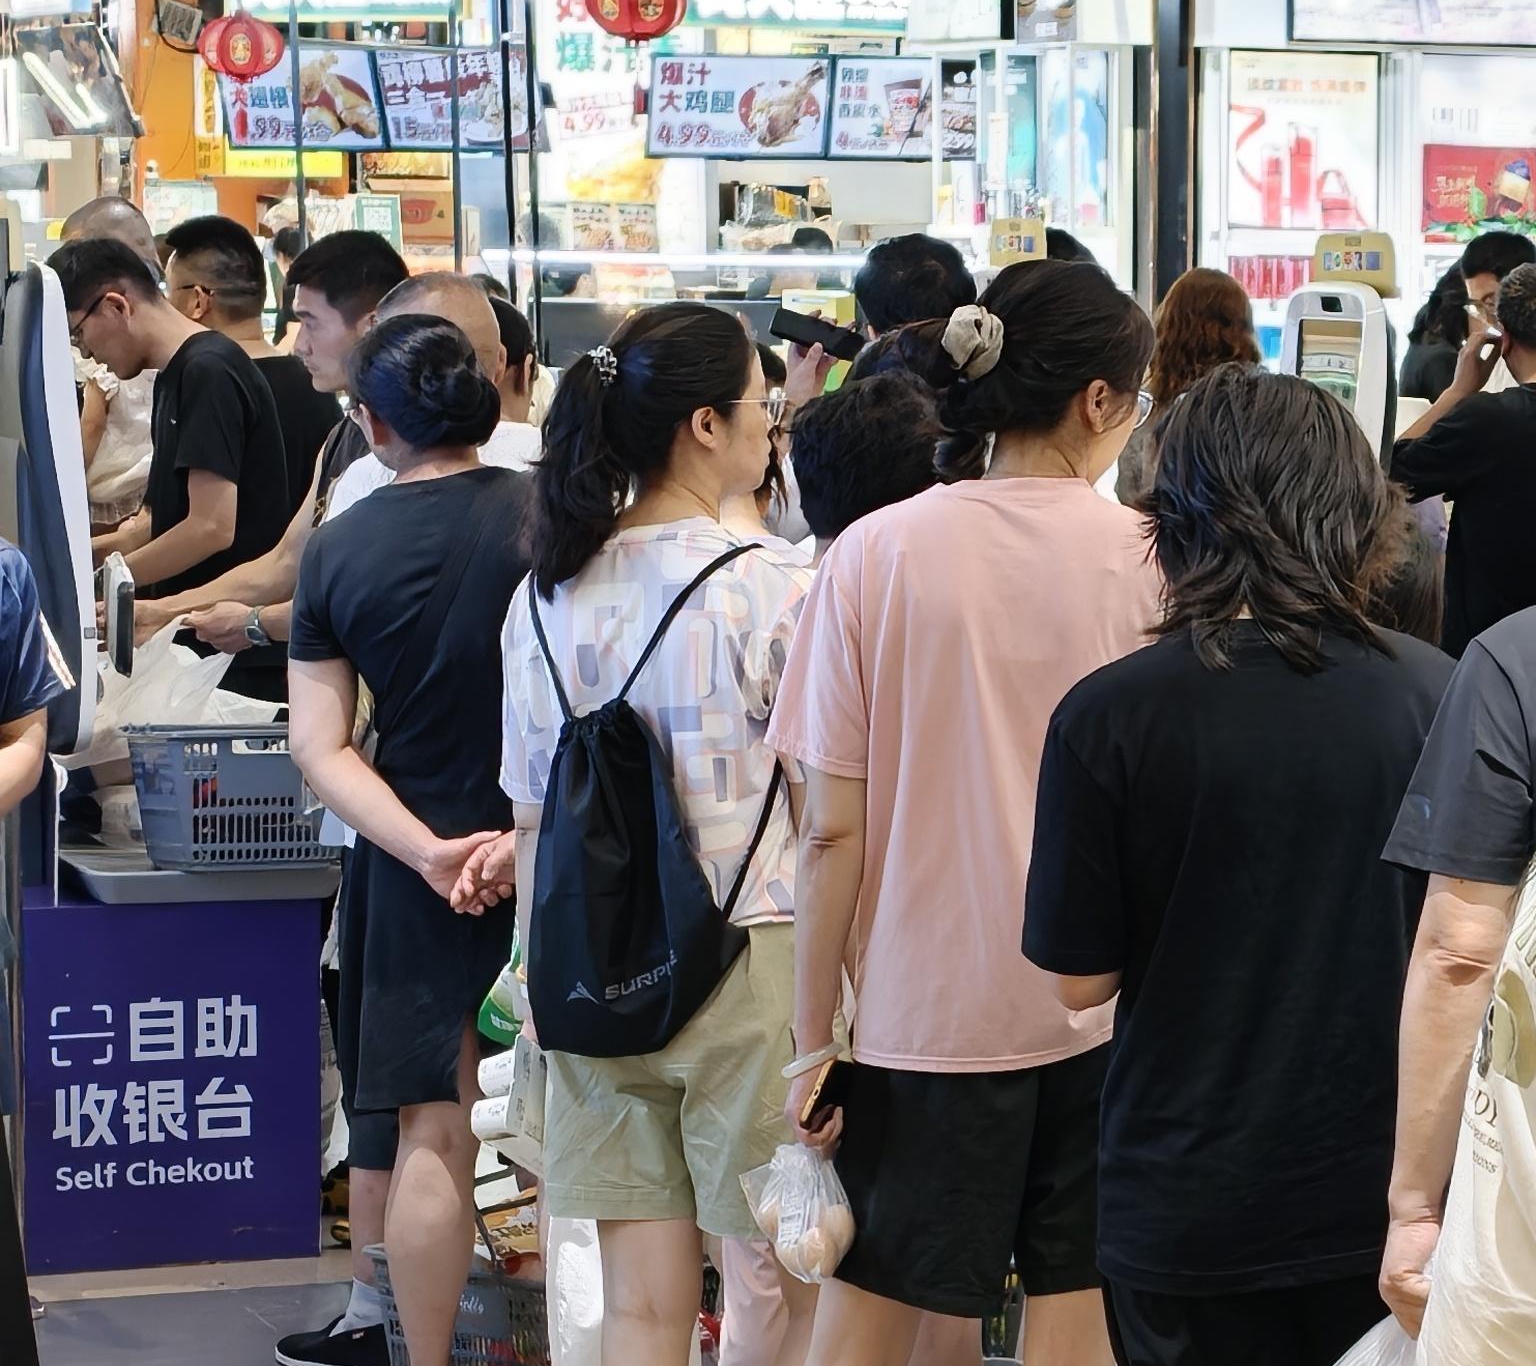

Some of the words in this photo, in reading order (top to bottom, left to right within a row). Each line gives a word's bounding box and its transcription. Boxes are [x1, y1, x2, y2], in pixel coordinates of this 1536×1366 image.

[128, 995, 258, 1062] 自助
[52, 1077, 254, 1148] 收银台
[55, 1162, 118, 1191] Self
[125, 1155, 255, 1187] Chekout
